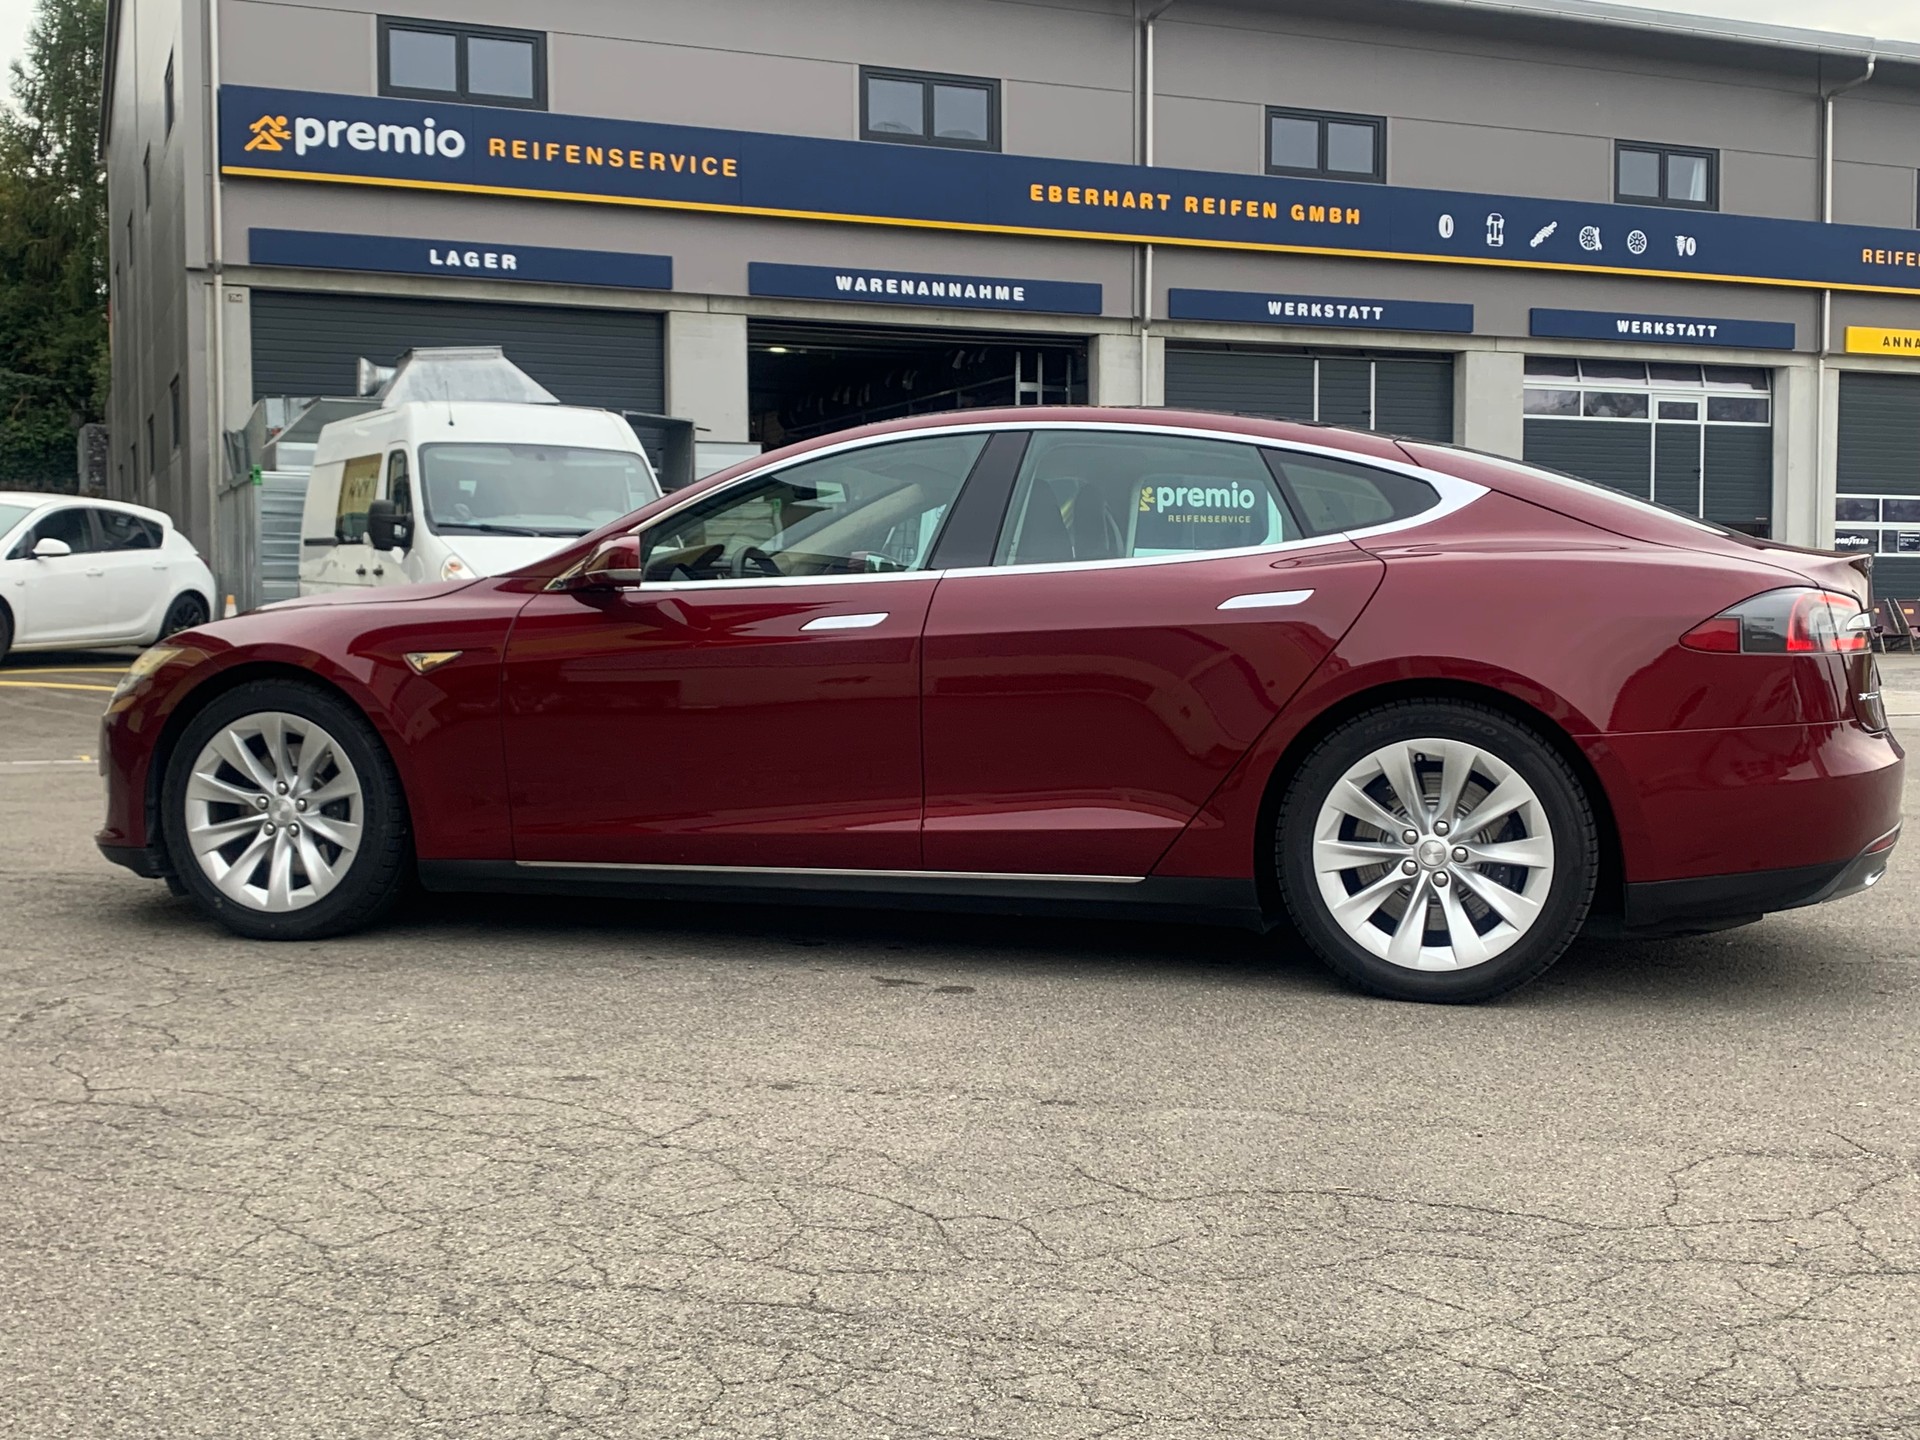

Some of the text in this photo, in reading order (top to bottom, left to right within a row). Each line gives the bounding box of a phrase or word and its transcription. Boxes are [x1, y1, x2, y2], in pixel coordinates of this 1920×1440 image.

[295, 116, 738, 178] premio REIFENSERVICE
[1030, 184, 1361, 225] EBERHART REIFEN GMBH
[429, 249, 518, 270] LAGER
[1862, 248, 1920, 267] REIFE
[835, 276, 1025, 302] WARENANNAHME
[1267, 301, 1384, 321] WERKSTATT
[1616, 319, 1718, 338] WERKSTATT
[1157, 481, 1255, 514] premio
[1167, 514, 1251, 524] REIFENSERVICE
[1834, 535, 1869, 546] OODYEAR
